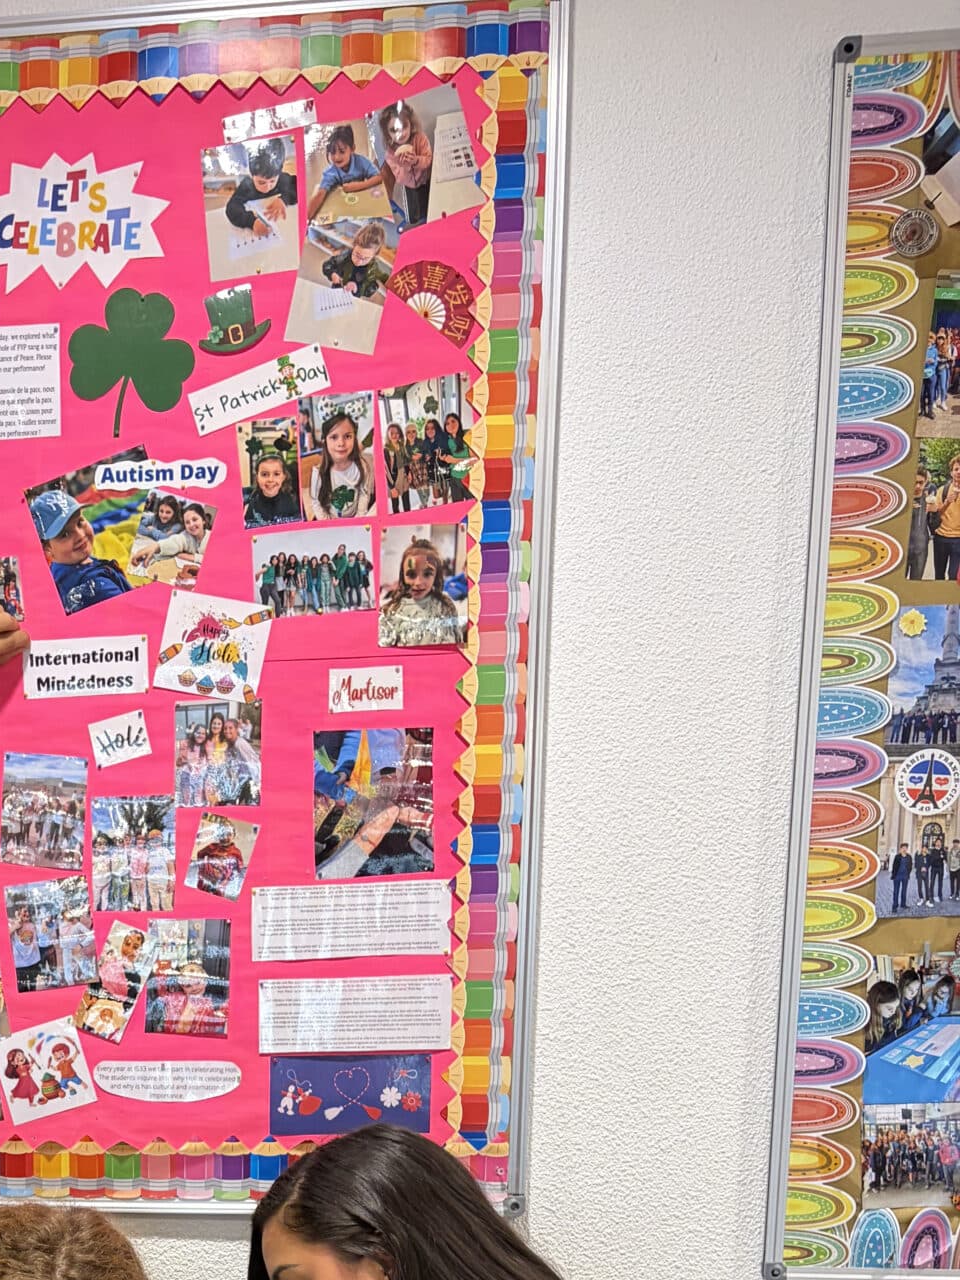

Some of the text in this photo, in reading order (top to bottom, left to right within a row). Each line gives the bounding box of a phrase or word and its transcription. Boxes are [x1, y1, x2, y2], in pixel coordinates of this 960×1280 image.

[37, 169, 107, 213] LET'S
[296, 365, 328, 382] Day
[100, 464, 219, 484] Autism Day
[202, 624, 230, 642] Happy
[29, 646, 139, 667] International
[192, 638, 233, 663] Holi
[37, 675, 133, 692] Mindedness
[333, 675, 398, 709] Martisor
